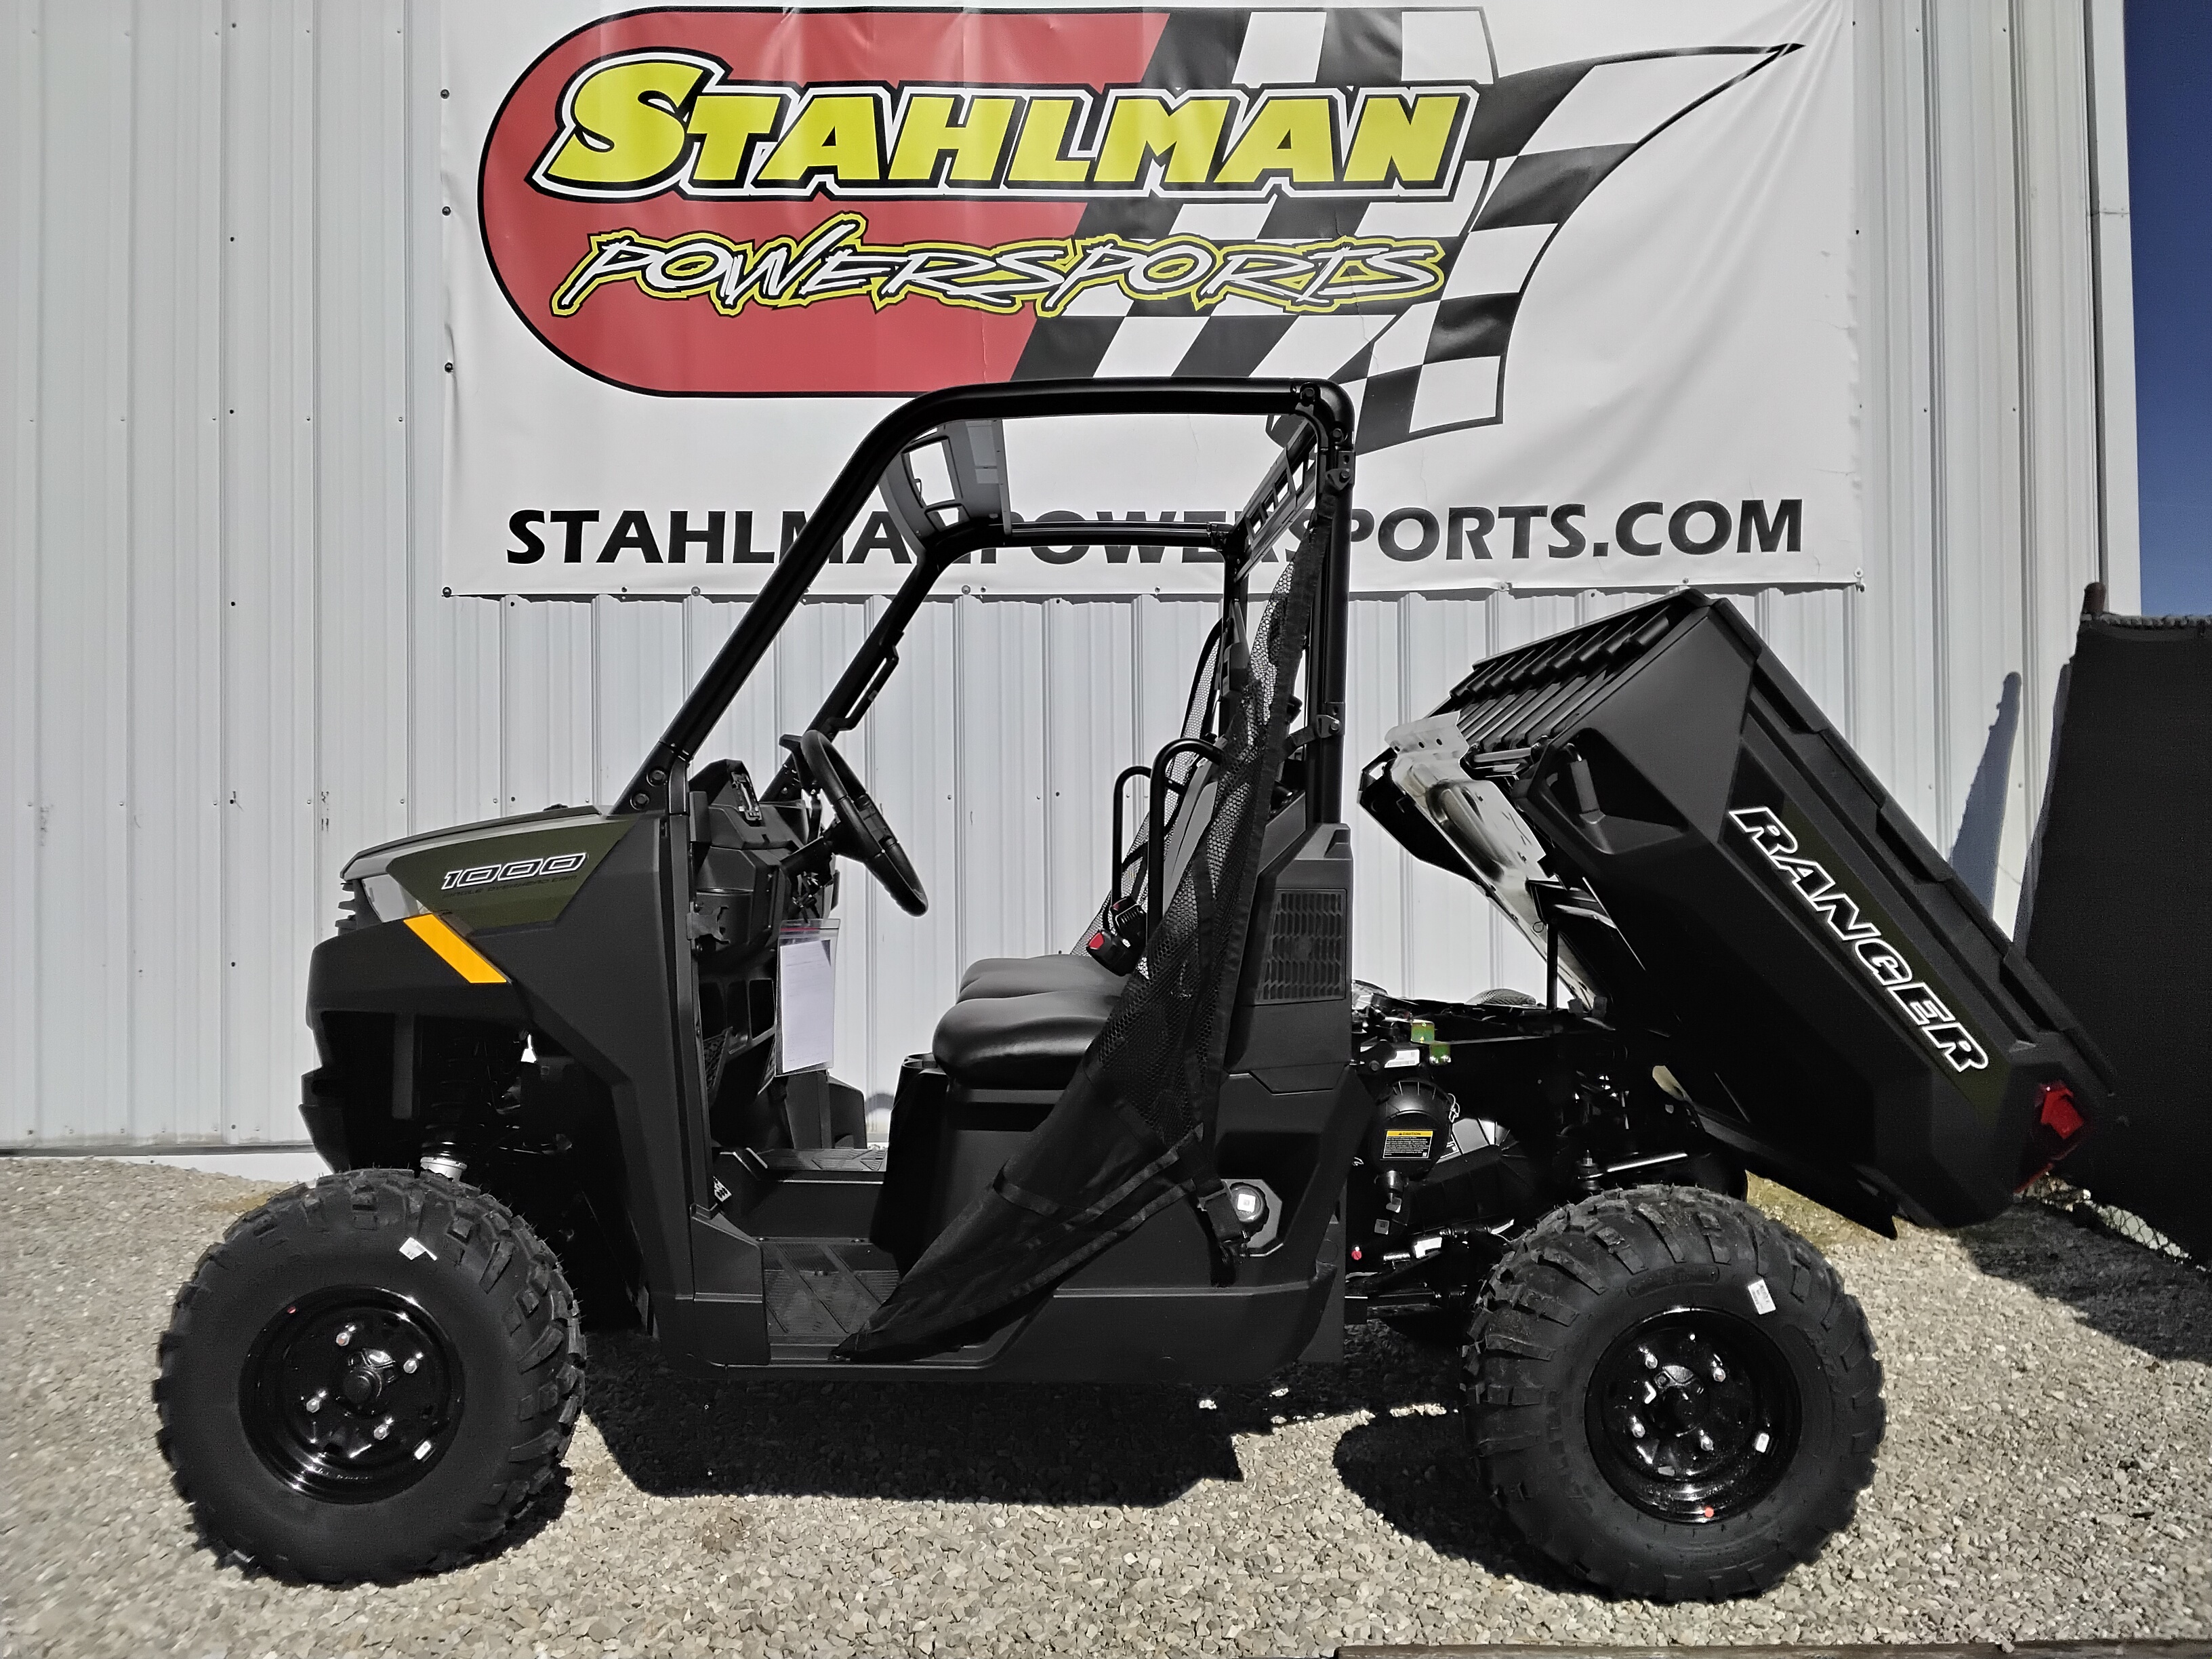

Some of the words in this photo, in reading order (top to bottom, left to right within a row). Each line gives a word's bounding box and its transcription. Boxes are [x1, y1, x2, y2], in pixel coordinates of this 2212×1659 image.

[529, 49, 1477, 199] STAHLMAN
[552, 211, 1445, 316] POWERSPORTS
[506, 499, 1803, 565] STAHLAOWEPORTS.COM
[441, 852, 588, 890] 1000
[1729, 806, 1988, 1072] RANGER
